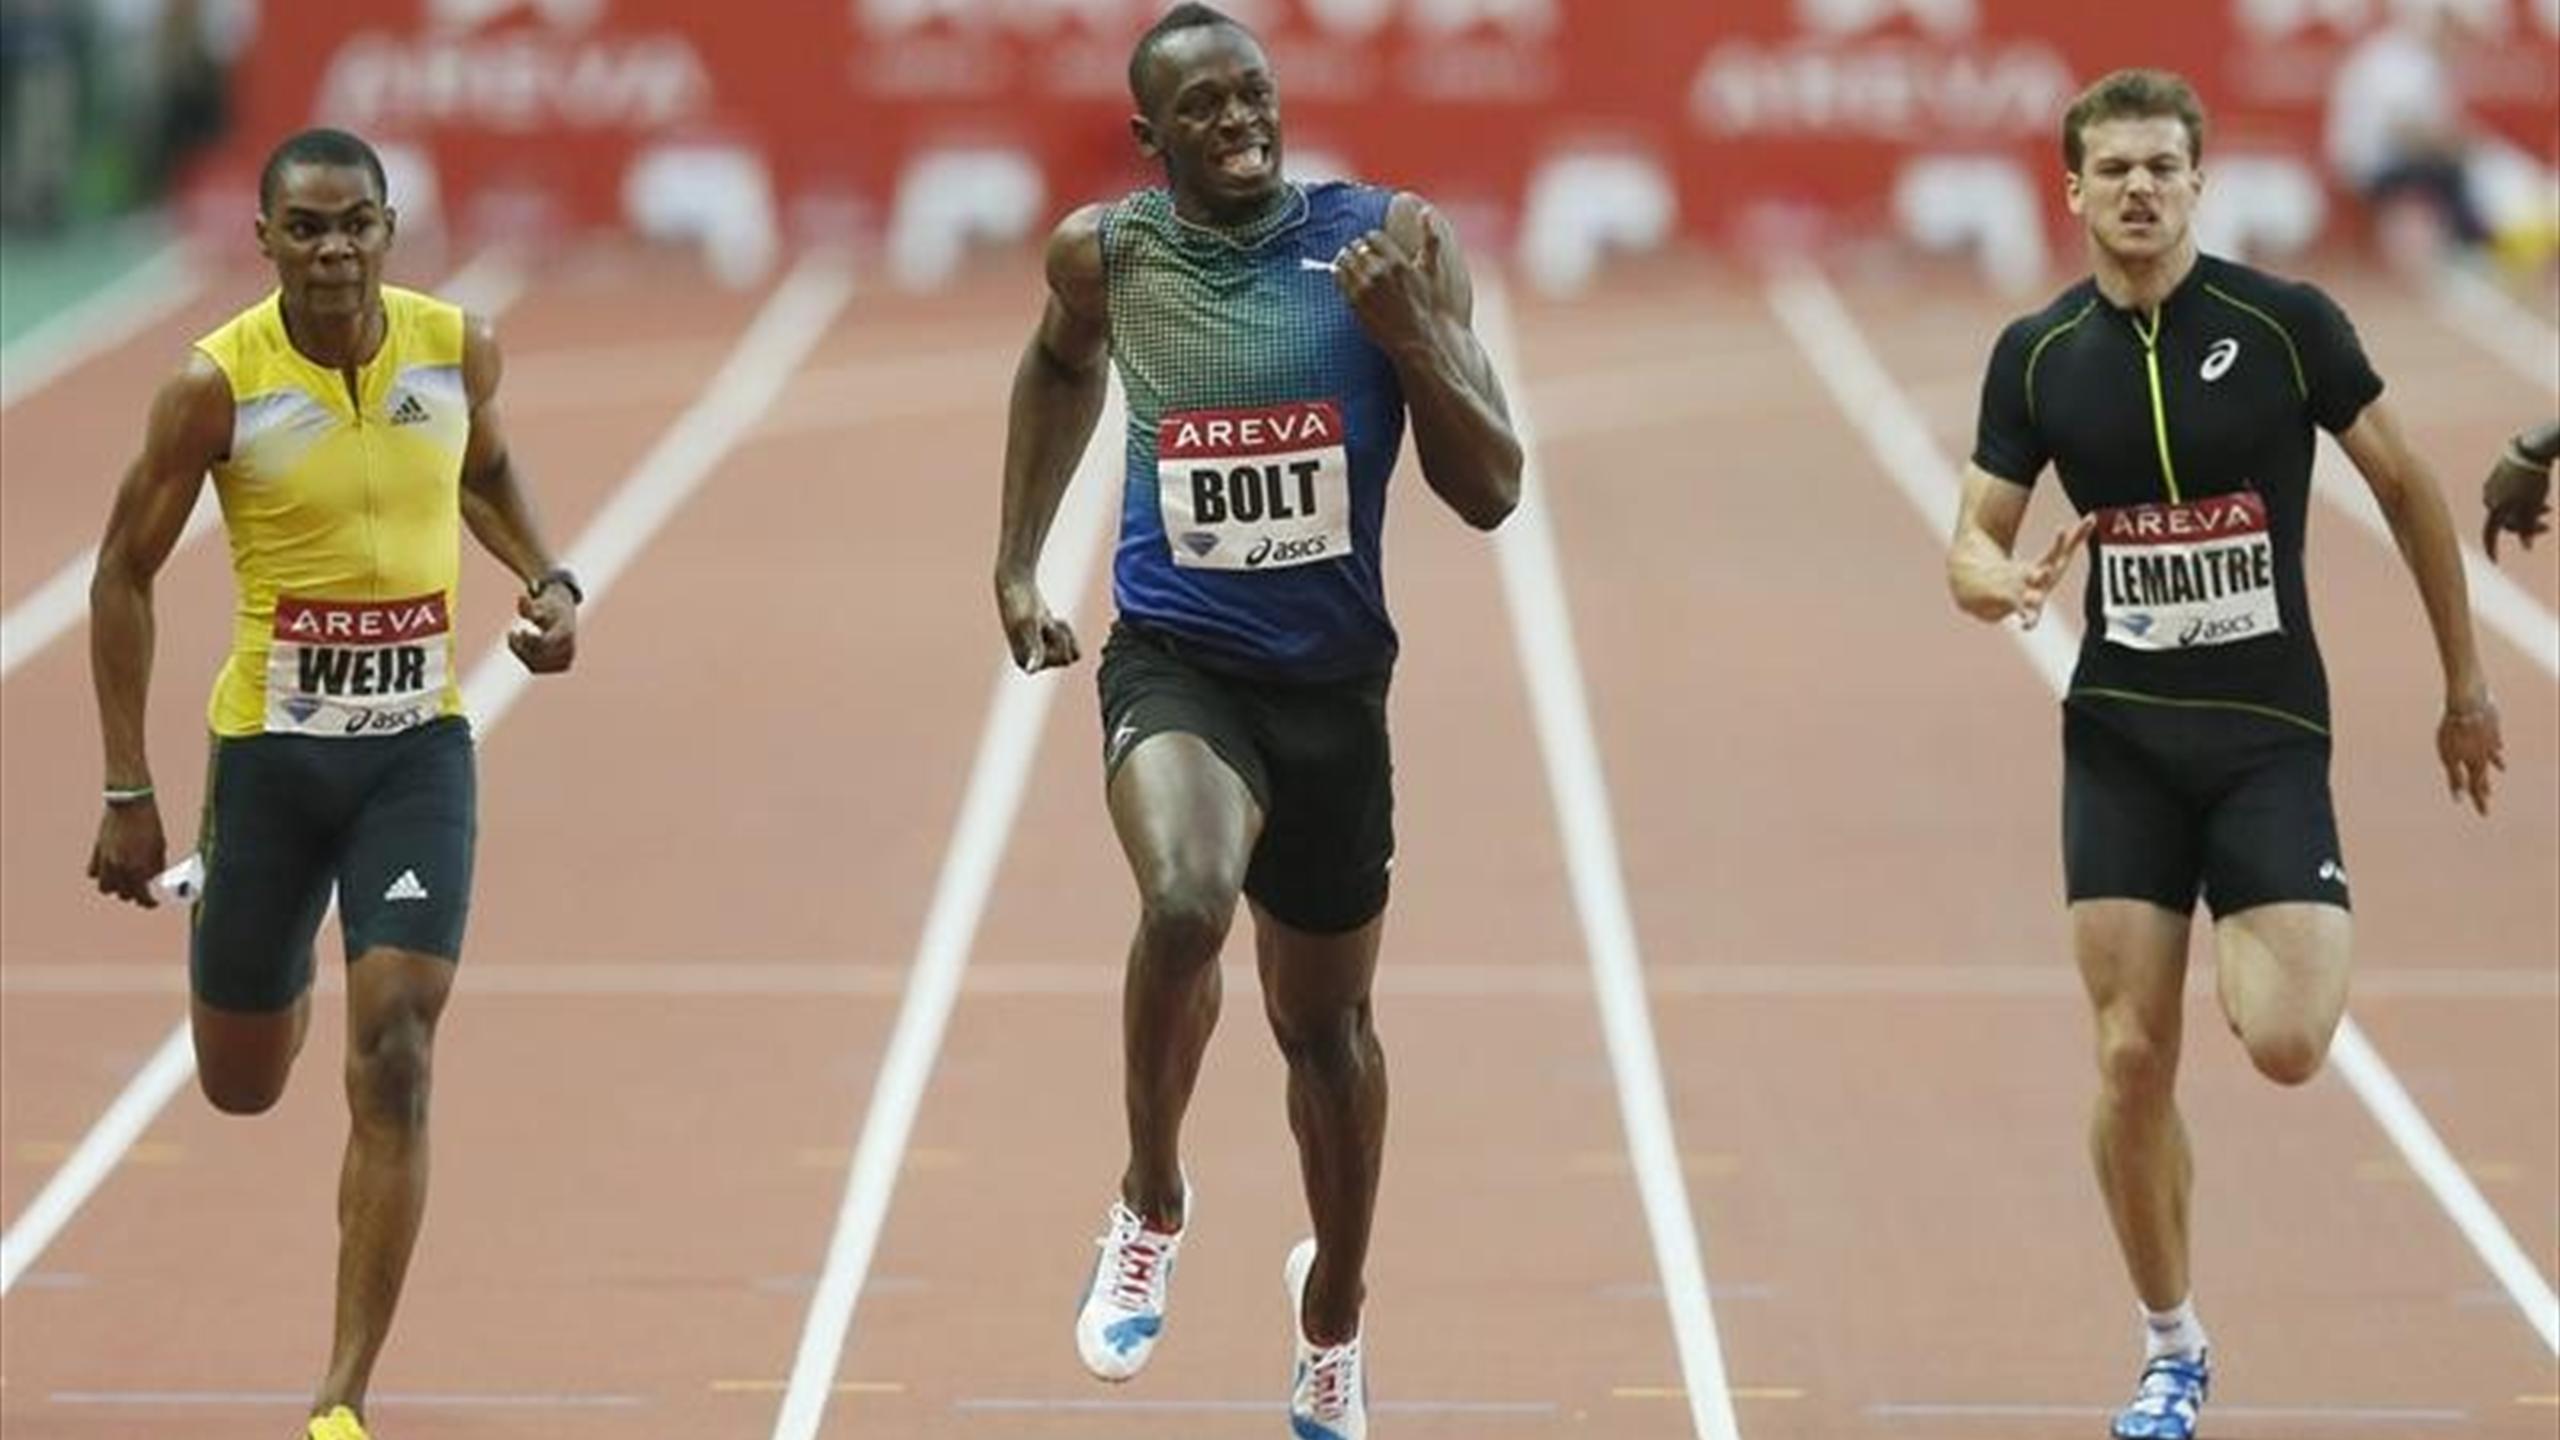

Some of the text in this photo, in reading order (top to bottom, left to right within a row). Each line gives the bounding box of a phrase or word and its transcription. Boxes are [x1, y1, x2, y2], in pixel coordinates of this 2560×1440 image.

[1175, 411, 1330, 449] AREVA
[1190, 459, 1321, 526] BOLT
[2111, 504, 2252, 536] AREVA
[1272, 535, 1329, 562] asics
[2108, 544, 2270, 607] LEMAITRE
[290, 604, 438, 636] AREVA
[298, 646, 427, 695] WEIR
